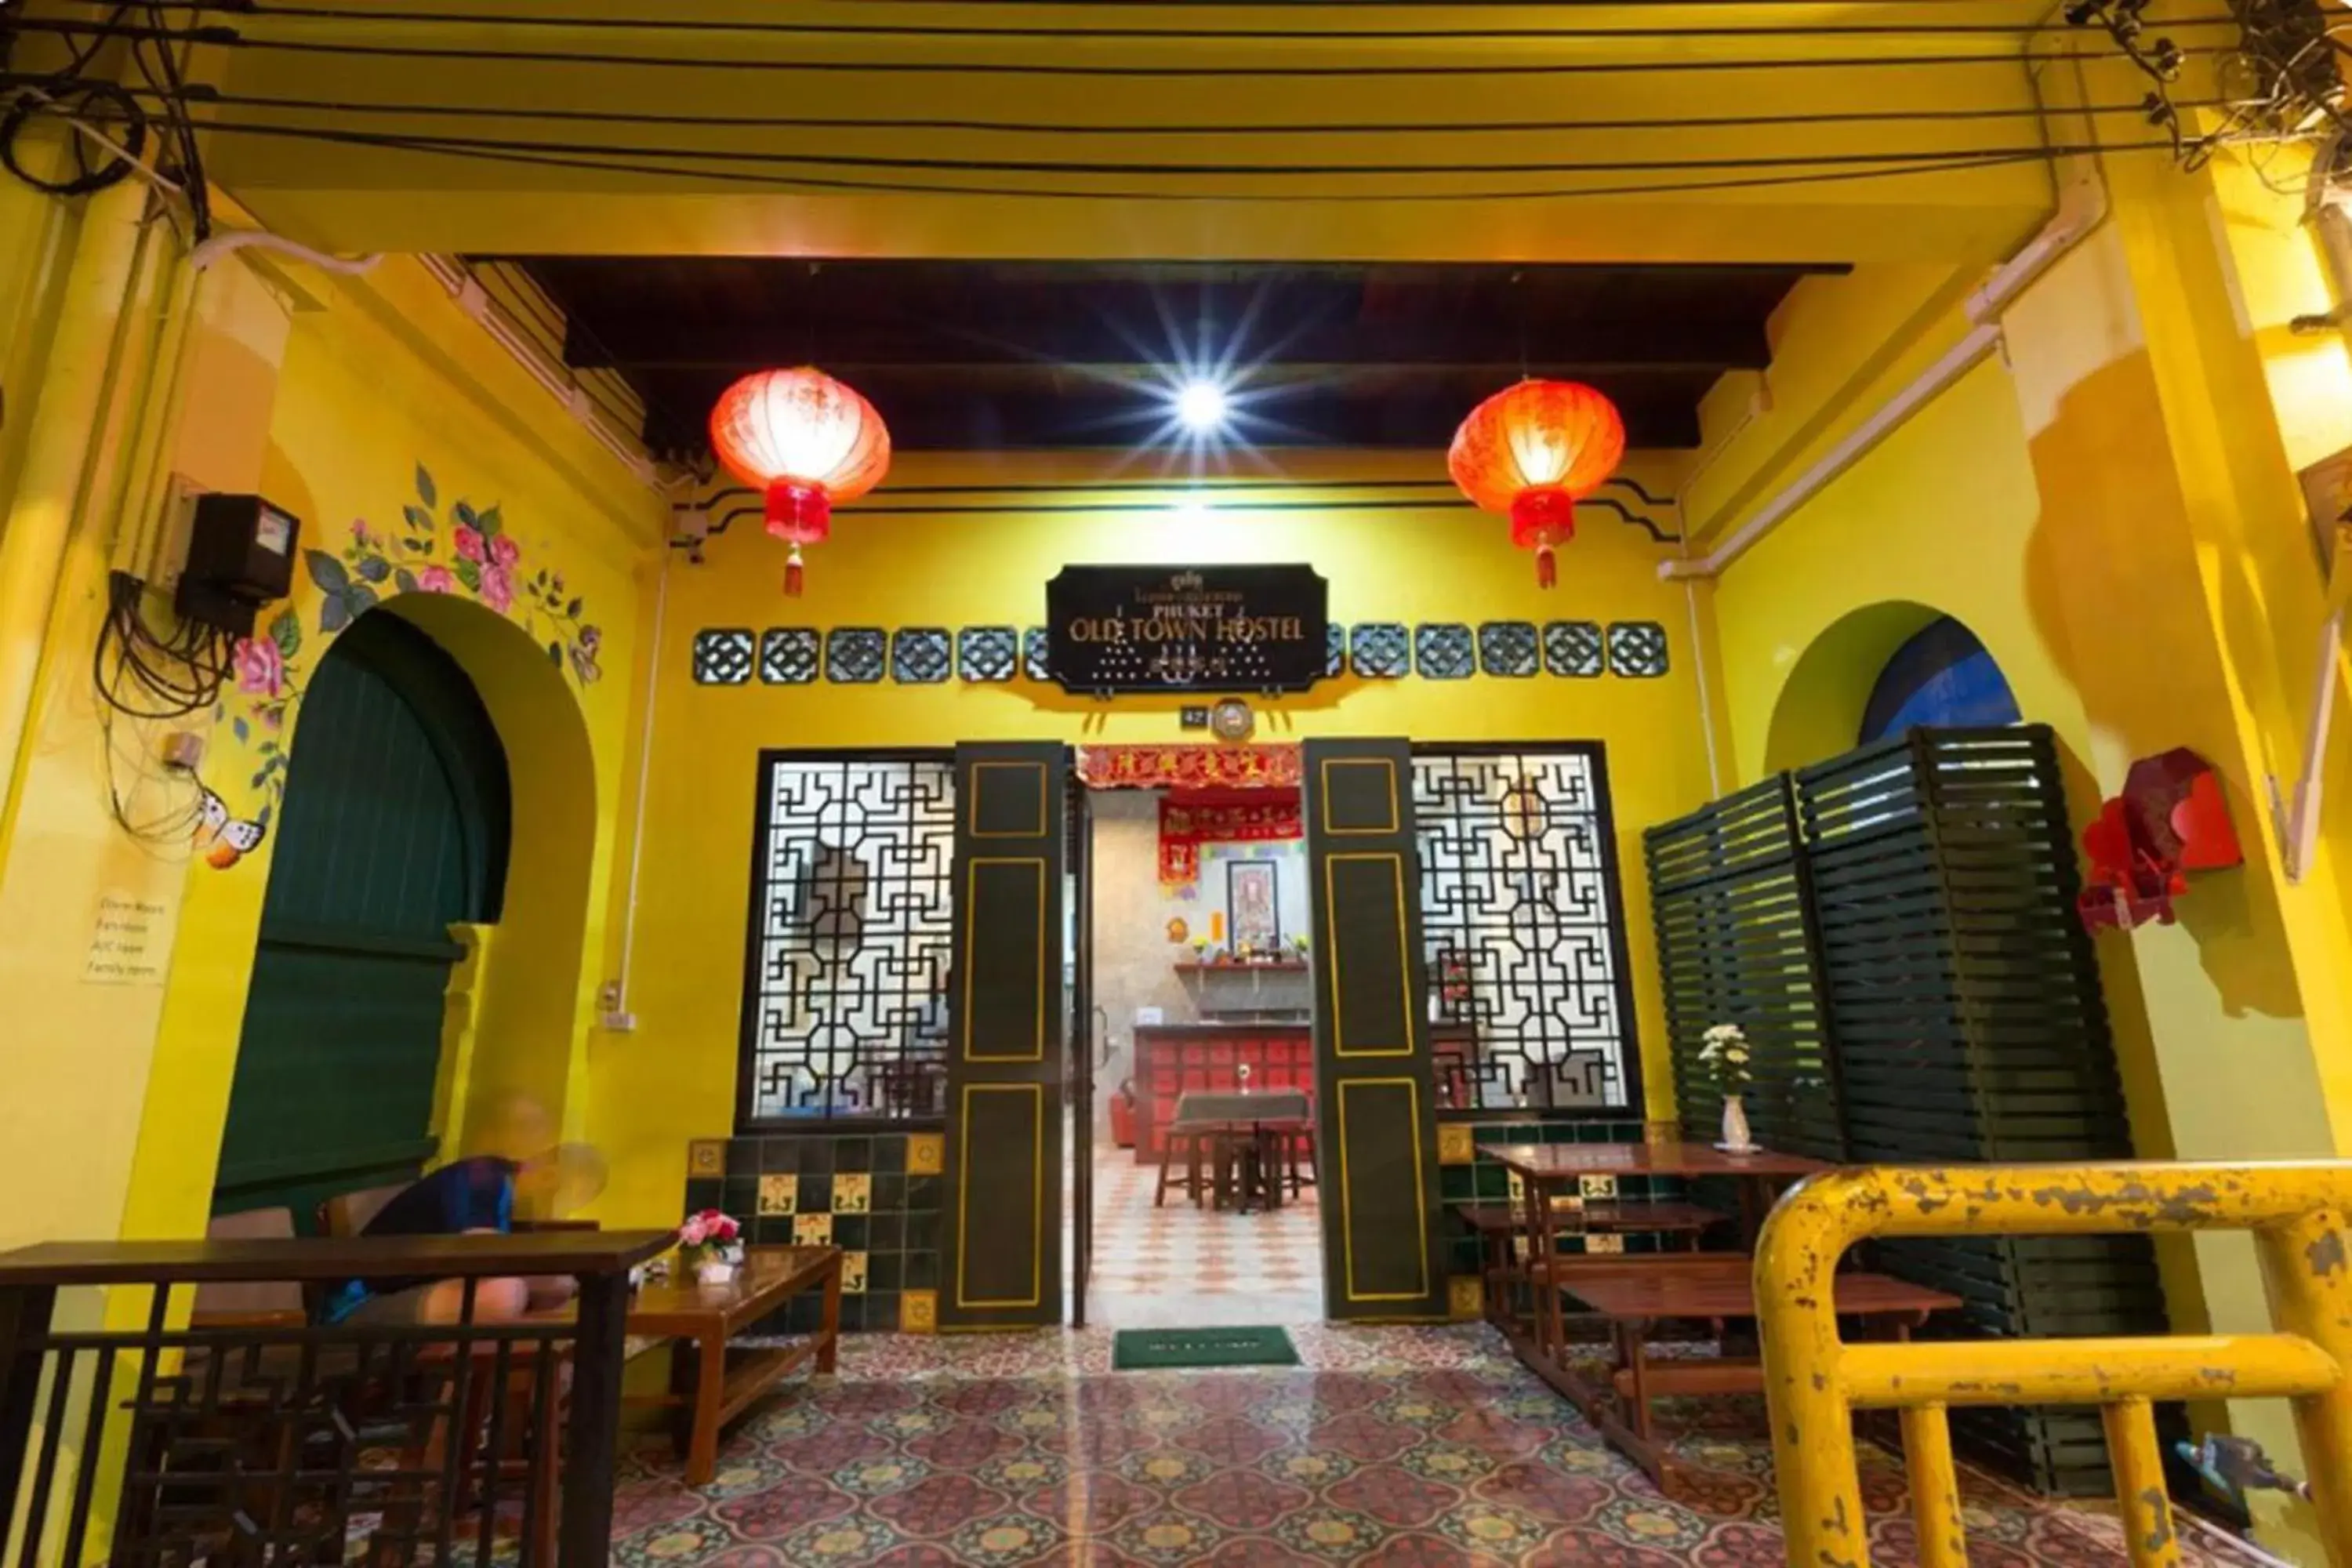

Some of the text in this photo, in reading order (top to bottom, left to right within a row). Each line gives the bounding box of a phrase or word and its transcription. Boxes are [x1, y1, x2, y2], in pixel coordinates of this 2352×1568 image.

[1153, 604, 1224, 619] PHUKET
[1069, 616, 1305, 642] OLD TOWN HOSTEL
[1184, 711, 1205, 724] 42
